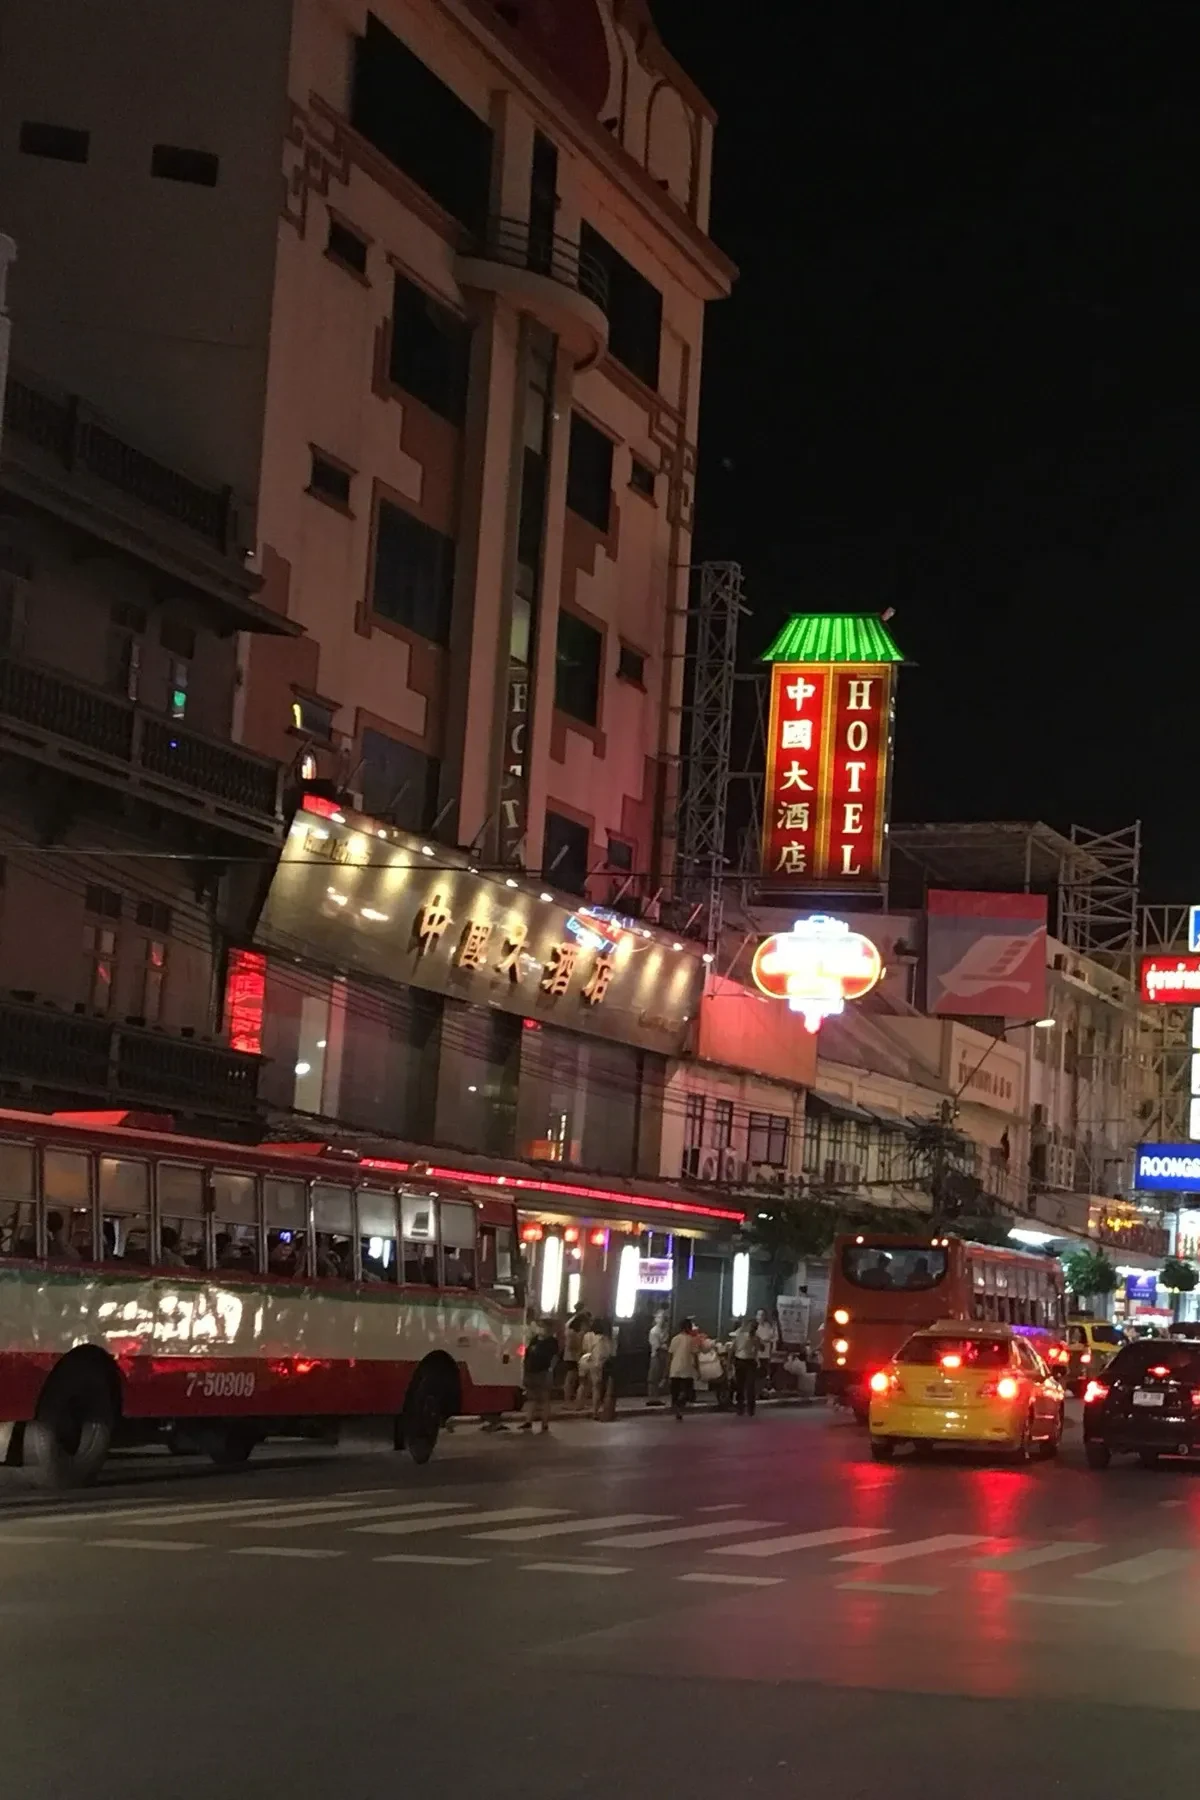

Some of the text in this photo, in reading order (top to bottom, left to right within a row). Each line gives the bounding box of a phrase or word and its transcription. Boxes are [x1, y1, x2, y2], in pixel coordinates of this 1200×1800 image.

[775, 677, 817, 875] 中國大酒店
[841, 680, 874, 875] HOTEL
[186, 1371, 256, 1398] 7-50309
